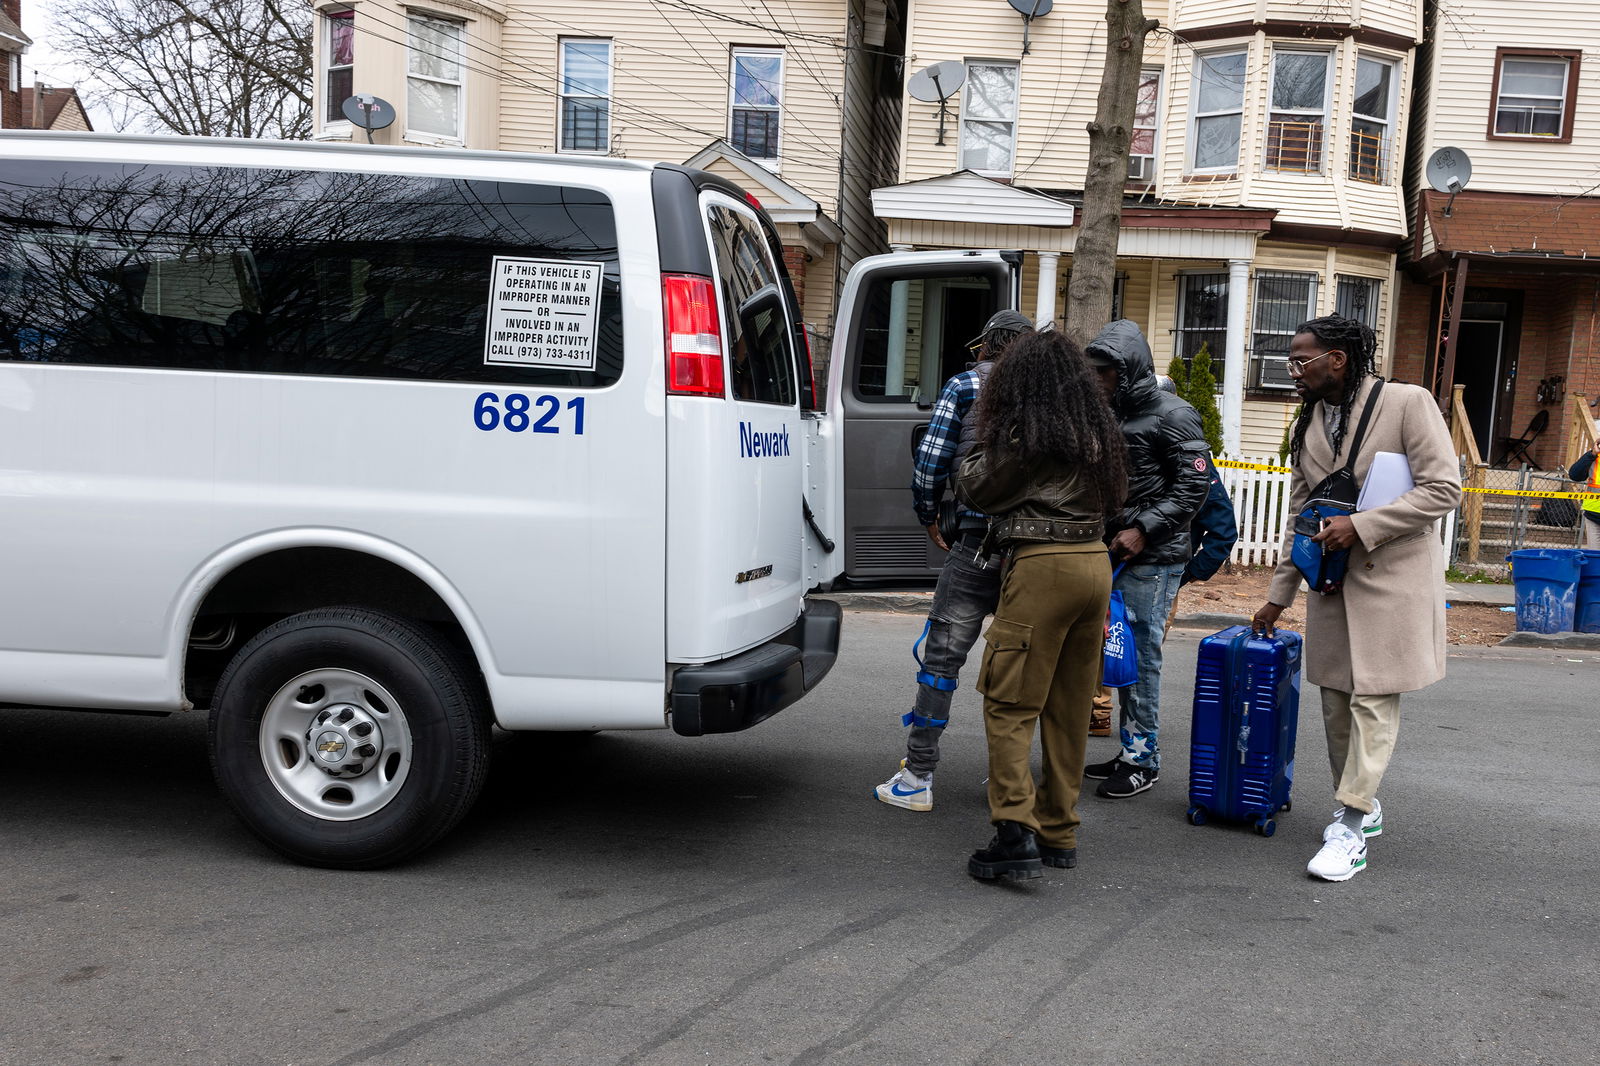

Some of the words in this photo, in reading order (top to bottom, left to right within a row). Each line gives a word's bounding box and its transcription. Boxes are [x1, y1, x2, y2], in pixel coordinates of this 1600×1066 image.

[503, 265, 513, 275] IF
[516, 266, 537, 276] THIS
[540, 267, 579, 279] VEHICLE
[582, 270, 591, 279] IS
[506, 278, 558, 291] OPERATING
[561, 281, 571, 292] IN
[574, 283, 587, 292] AN
[499, 291, 548, 304] IMPROPER
[551, 294, 591, 306] MANNER
[537, 307, 550, 317] OR
[505, 319, 551, 330] INVOLVED
[554, 321, 564, 331] IN
[567, 322, 580, 332] AN
[494, 331, 543, 344] IMPROPER
[546, 335, 589, 346] ACTIVITY
[491, 345, 514, 356] CALL
[517, 346, 542, 359] (973)
[546, 348, 591, 360] 733-4311
[474, 392, 585, 435] 6821
[739, 421, 790, 458] Newark
[1218, 461, 1255, 469] CAUTION
